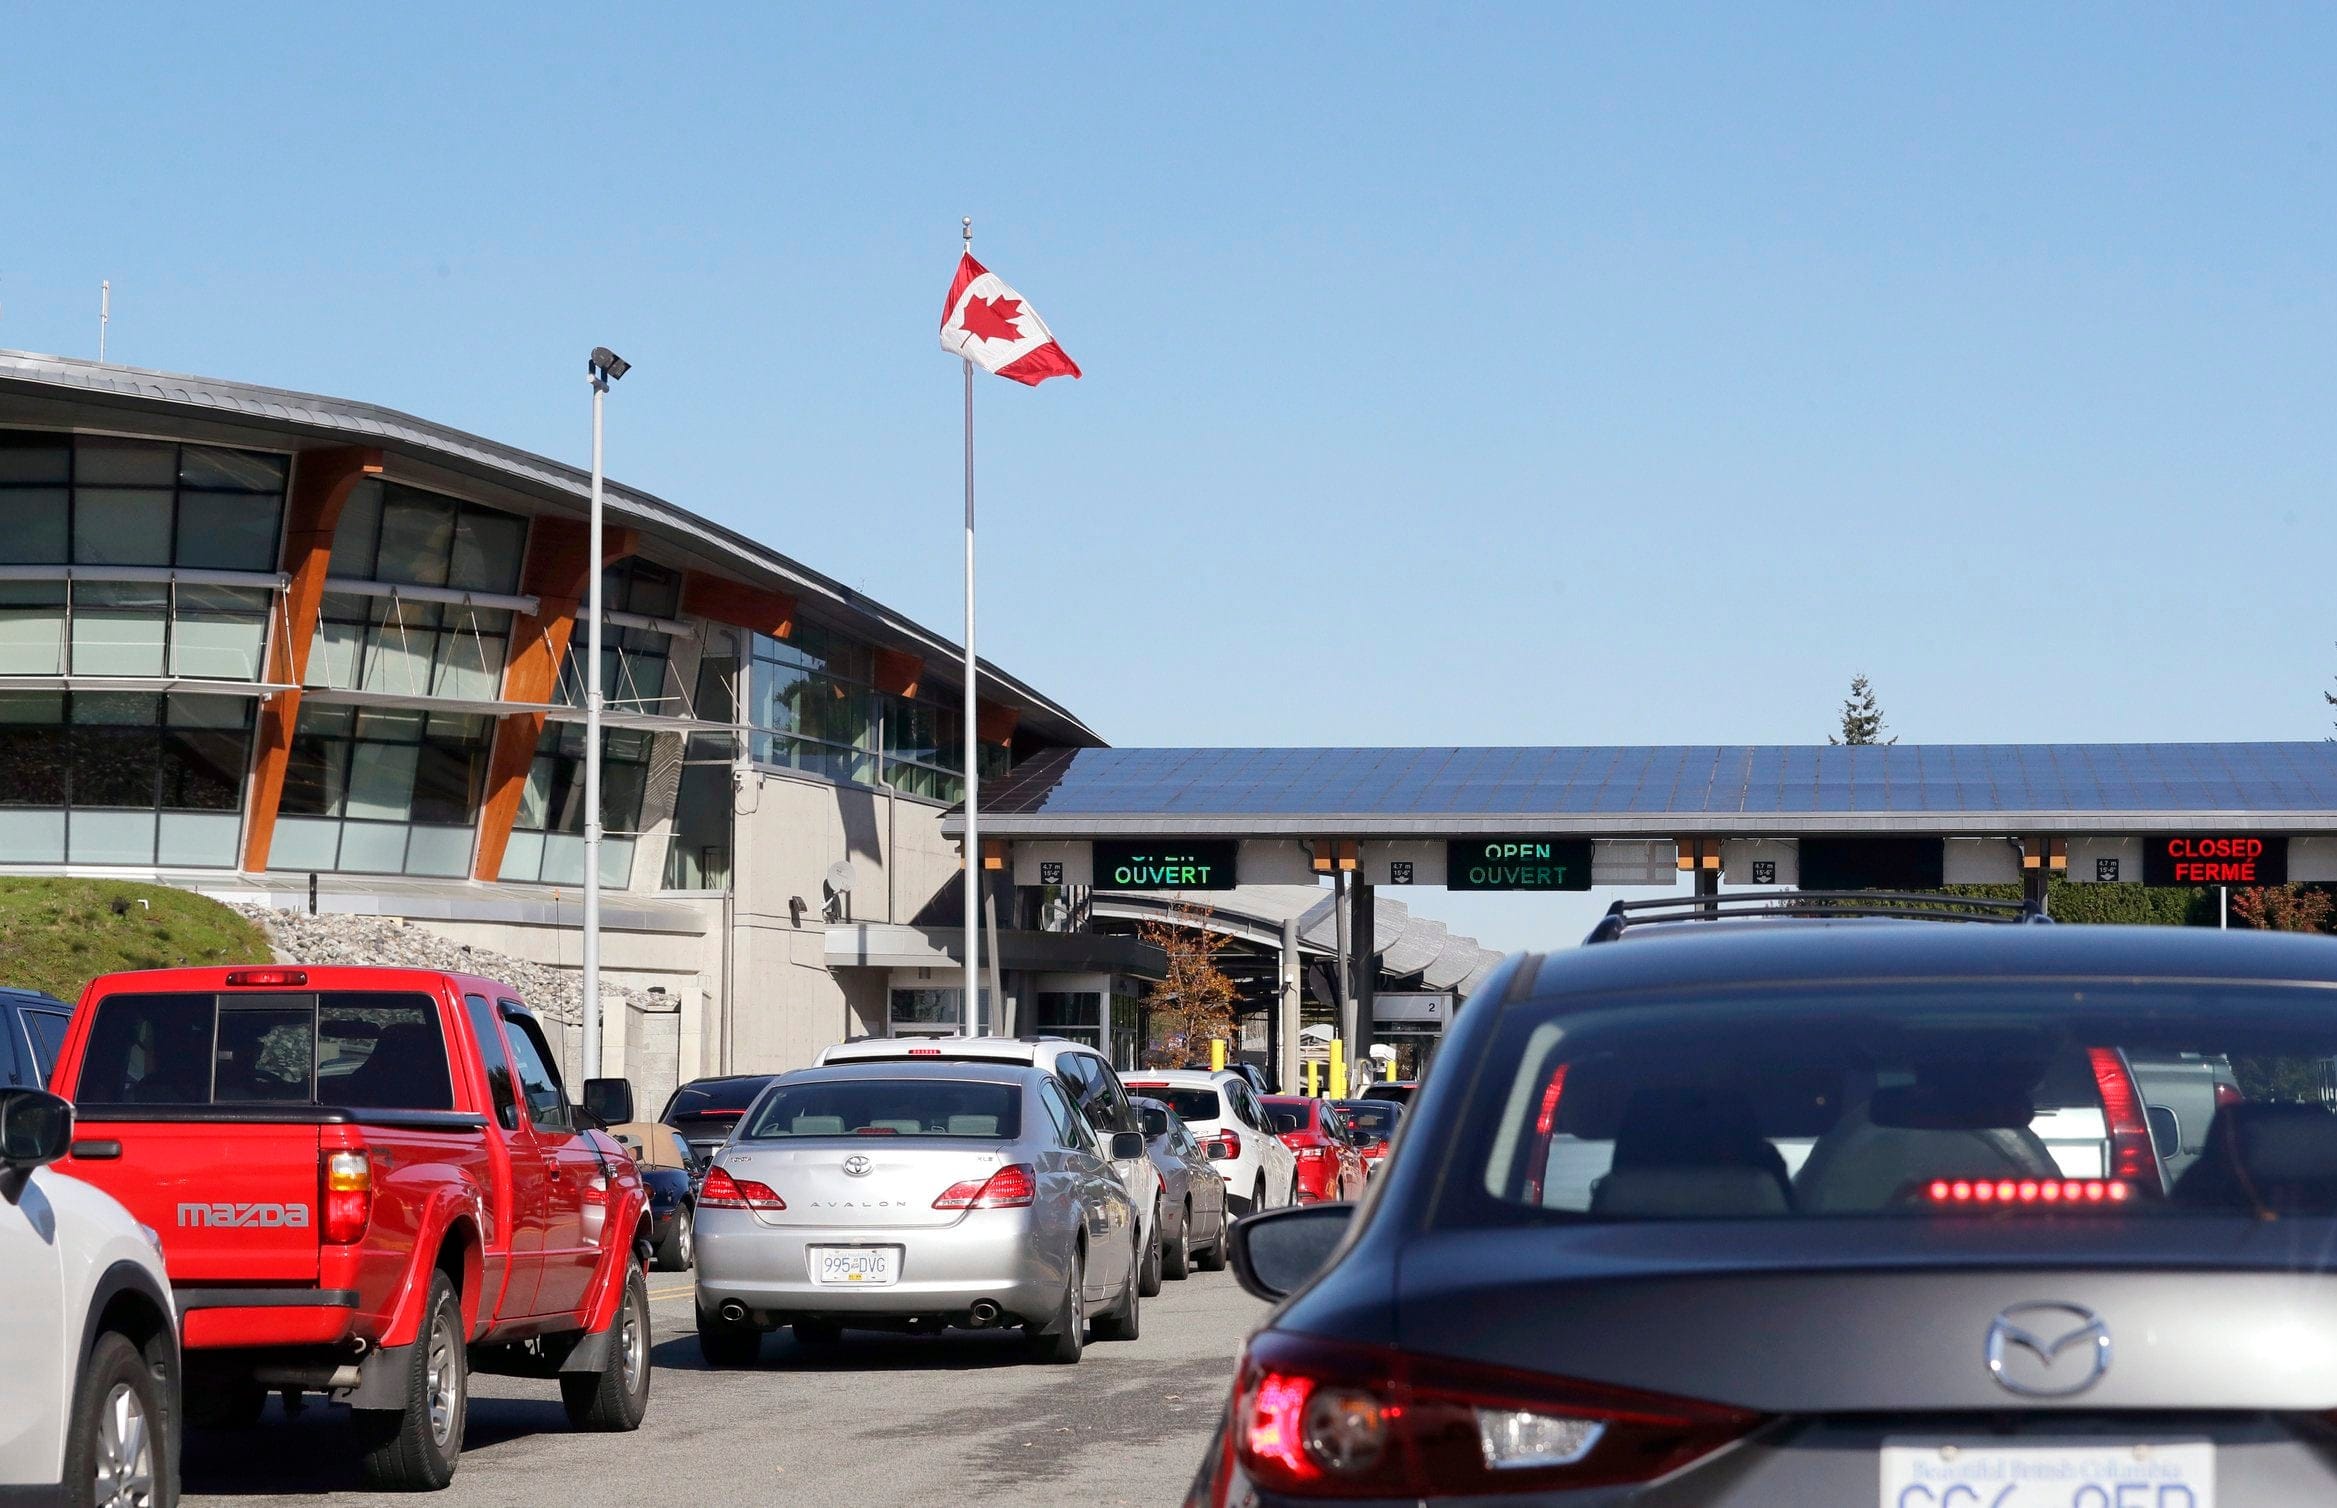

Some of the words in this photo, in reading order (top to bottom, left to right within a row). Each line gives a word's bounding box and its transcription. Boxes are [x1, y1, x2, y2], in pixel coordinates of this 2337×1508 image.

[1485, 844, 1551, 860] OPEN
[2168, 839, 2263, 857] CLOSED
[1115, 866, 1211, 884] OUVERT
[1469, 866, 1567, 884] OUVERT
[2175, 858, 2256, 881] FERMÉ
[1428, 1003, 1436, 1012] 2
[824, 1257, 851, 1272] 995
[859, 1257, 885, 1272] DVG
